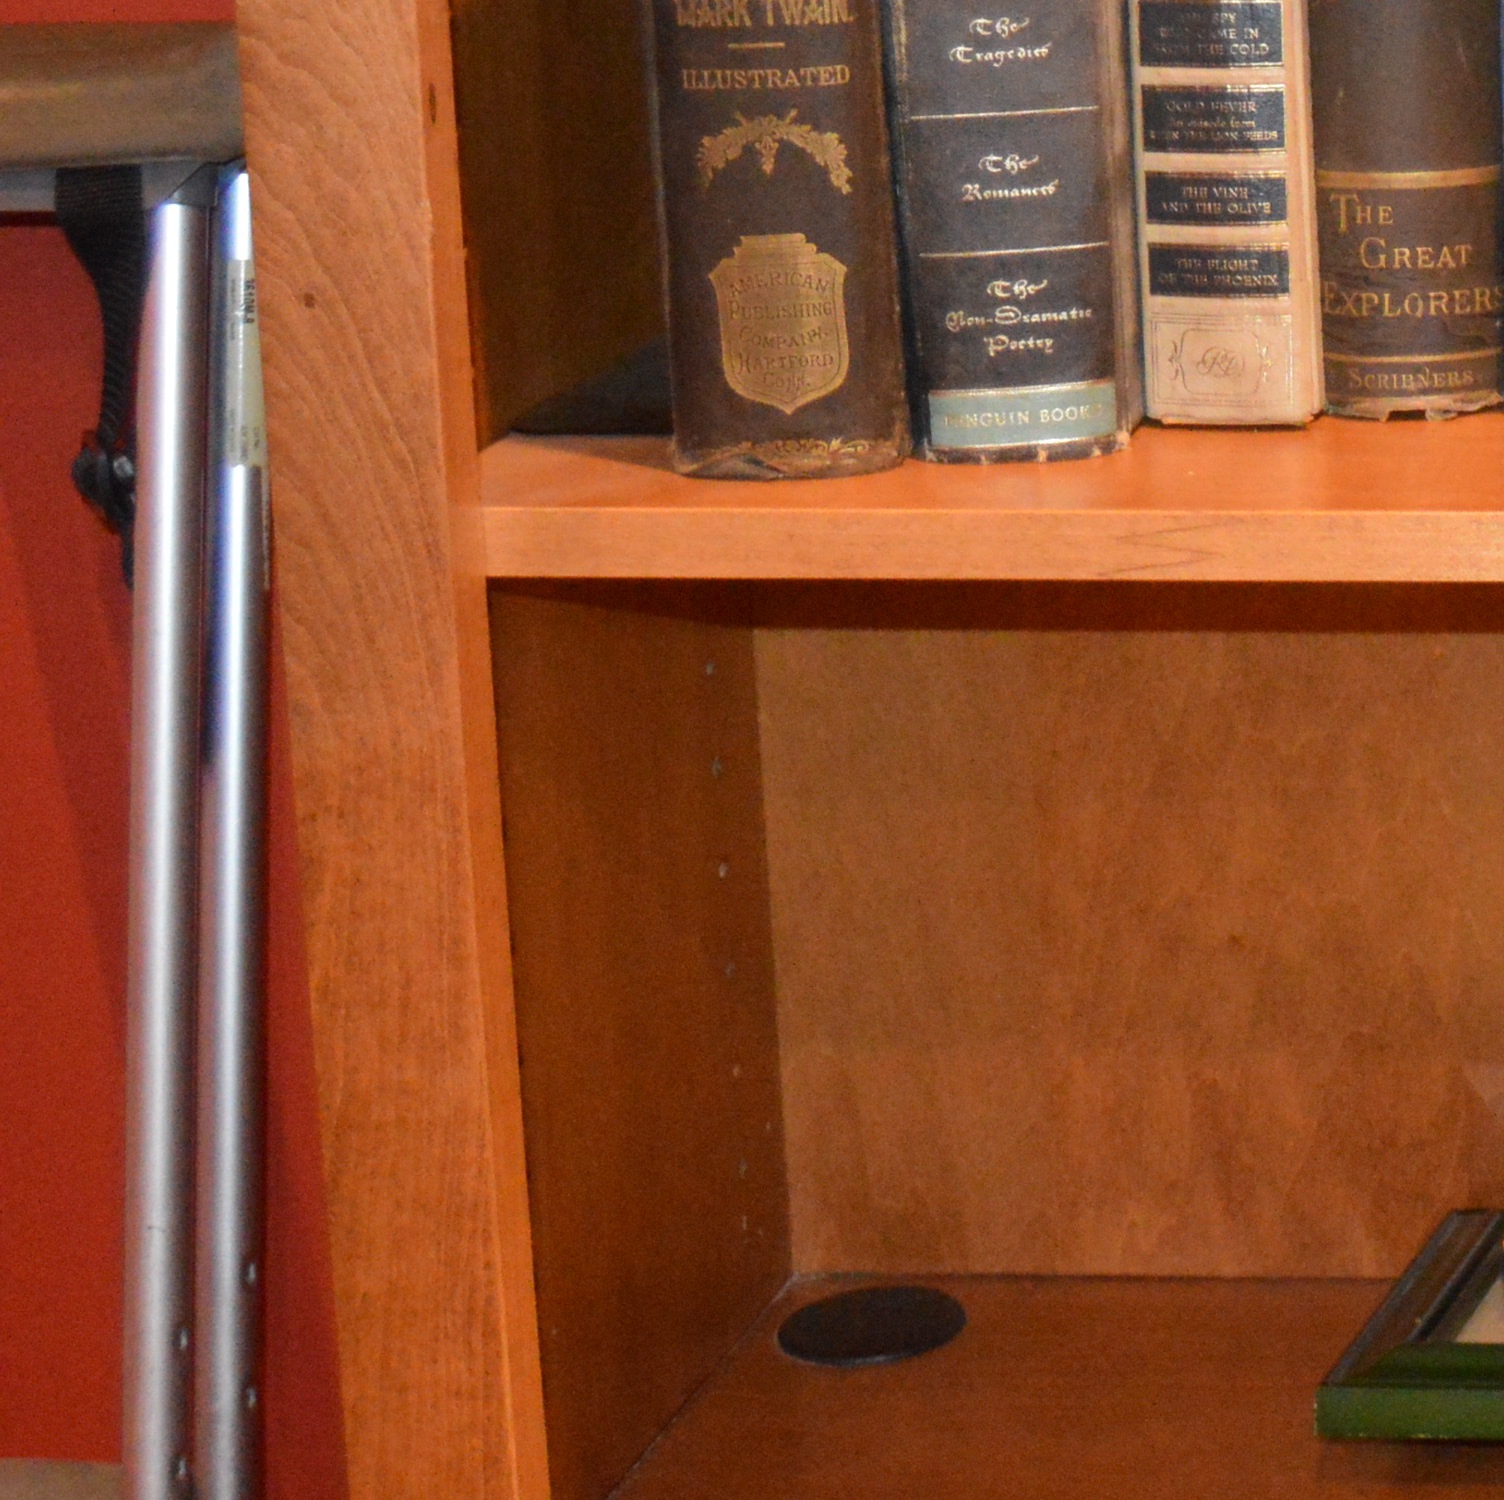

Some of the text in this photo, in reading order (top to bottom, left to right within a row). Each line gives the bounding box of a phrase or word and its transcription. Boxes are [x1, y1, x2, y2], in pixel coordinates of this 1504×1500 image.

[968, 16, 1029, 38] The
[949, 41, 1052, 68] Tragedies
[1230, 43, 1270, 56] COLD
[681, 65, 851, 91] ILLUSTRATED
[978, 153, 1039, 174] The
[961, 178, 1059, 201] Romances
[1227, 202, 1272, 215] OLIVE
[1329, 192, 1394, 235] THE
[1358, 237, 1473, 270] GREAT
[729, 269, 830, 299] AMERICAN
[987, 278, 1049, 300] The
[729, 298, 833, 321] PUBLISHING
[1321, 281, 1504, 318] EXPLORERS
[983, 333, 1055, 356] Poetry
[1038, 404, 1102, 423] BOOK
